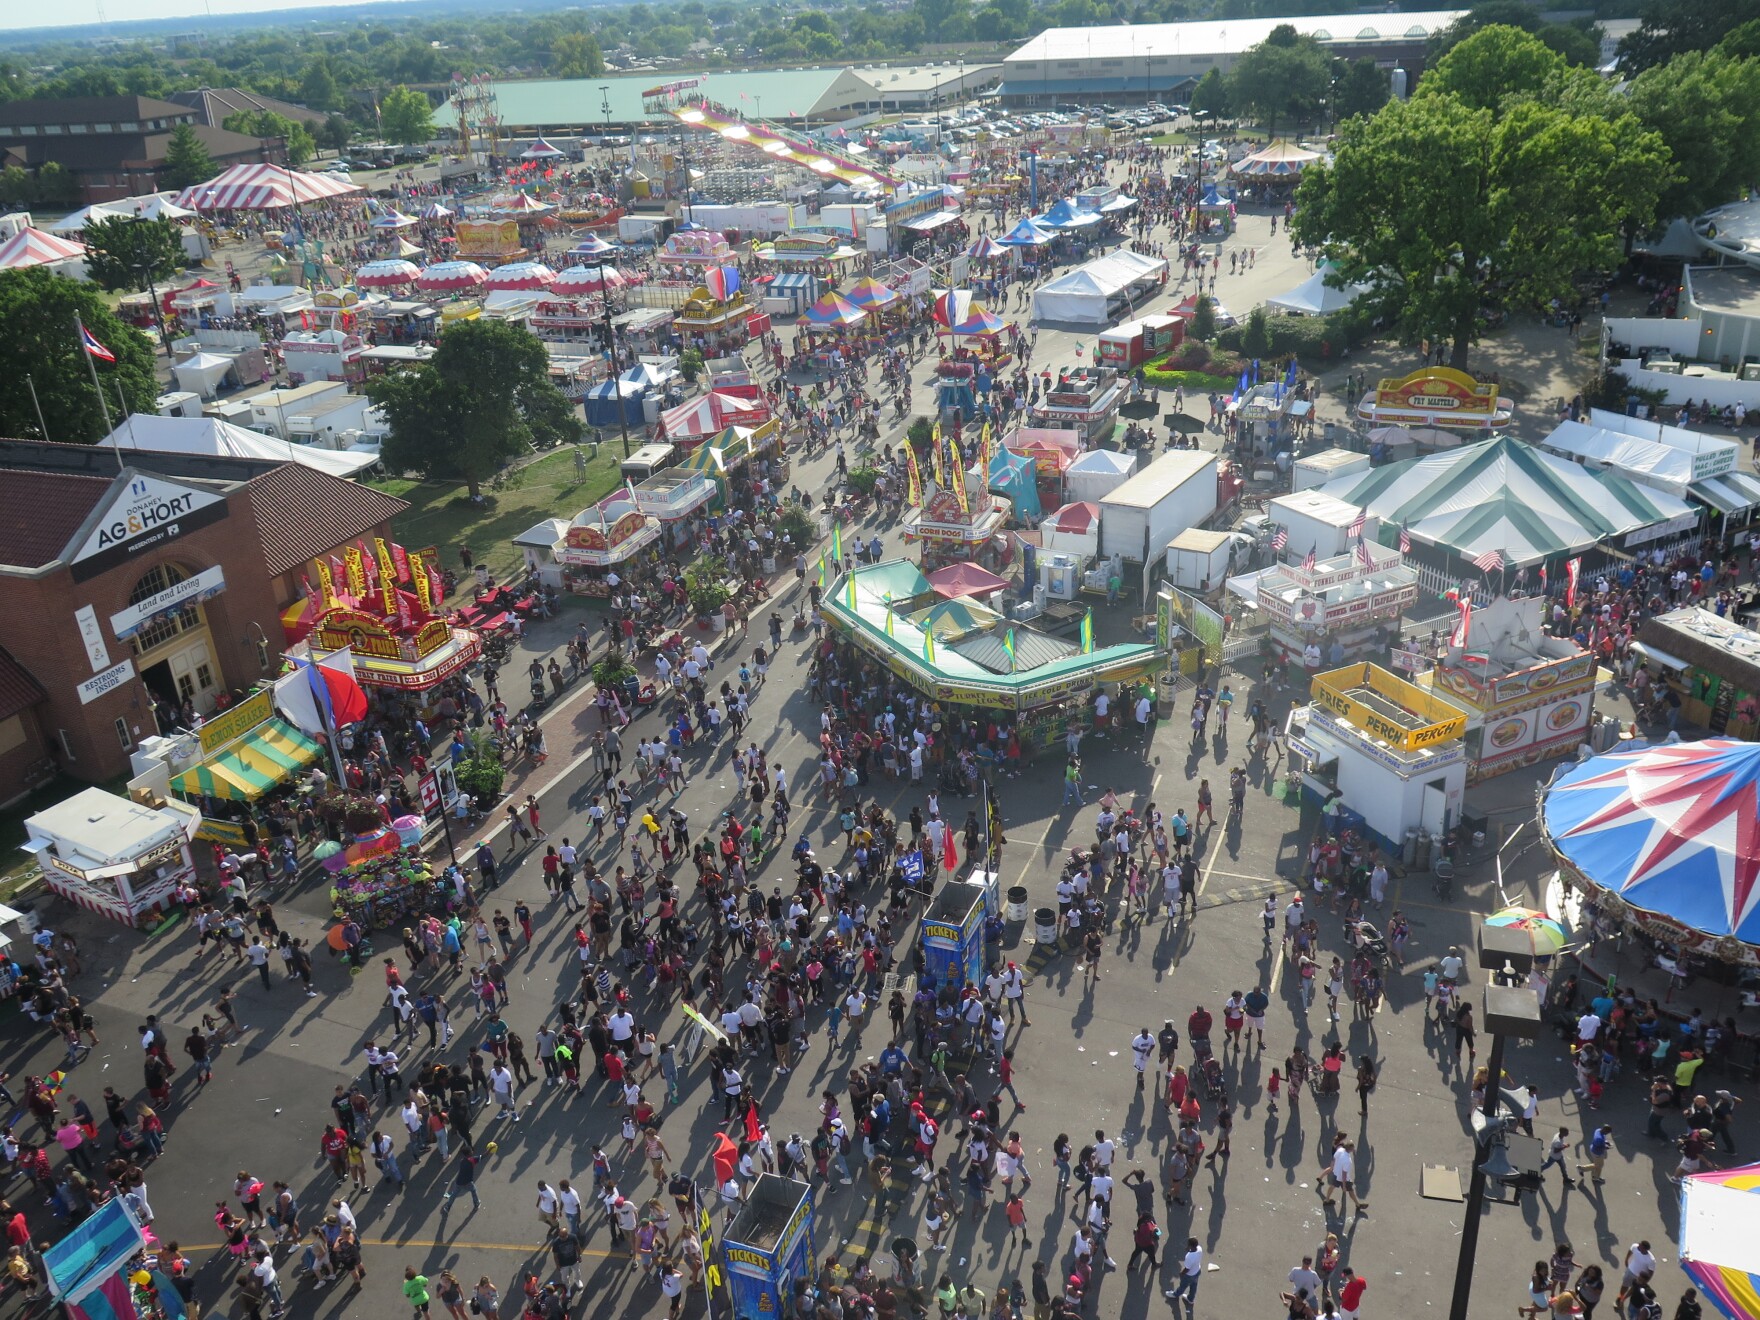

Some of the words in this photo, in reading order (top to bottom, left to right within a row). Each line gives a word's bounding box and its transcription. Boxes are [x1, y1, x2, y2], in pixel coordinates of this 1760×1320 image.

[1413, 396, 1424, 405] FRY
[1695, 452, 1716, 462] PULLED
[1718, 448, 1735, 456] PORK
[1694, 462, 1708, 471] MAC
[126, 496, 162, 516] DONAHEY
[920, 528, 941, 536] CORN
[942, 529, 962, 537] DOGS
[128, 536, 157, 552] PRESENTED
[1382, 558, 1400, 569] CAKES
[1314, 576, 1335, 588] FUNNEL
[1337, 571, 1354, 581] CAKES
[138, 598, 158, 613] Land
[160, 590, 175, 604] and
[176, 578, 200, 594] Living
[1158, 604, 1168, 648] CORN
[321, 631, 348, 649] CURLY
[370, 638, 396, 655] FRIES
[439, 659, 456, 673] CURLY
[458, 647, 473, 659] FRIES
[84, 664, 126, 692] RESTROOMS
[95, 677, 120, 694] INSIDE
[378, 673, 398, 683] FRIES
[404, 674, 420, 684] CORN
[422, 671, 436, 680] DOGS
[904, 668, 932, 696] CORN
[1025, 692, 1038, 700] ICE
[1042, 685, 1062, 695] COLD
[1066, 676, 1095, 689] DRINKS
[1320, 688, 1350, 716] FRIES
[1366, 716, 1402, 744] PERCH
[204, 723, 234, 750] LEMON
[1313, 714, 1330, 727] PERCH
[1334, 726, 1350, 740] FRIES
[1414, 722, 1456, 744] PERCH
[1292, 742, 1313, 758] PERCH
[1360, 742, 1378, 756] PERCH
[1384, 756, 1401, 770] FRIES
[1412, 760, 1433, 770] PERCH
[1440, 751, 1458, 762] FRIES
[148, 839, 179, 860] PIZZA
[366, 846, 384, 858] FANS
[58, 860, 78, 874] PIZZA
[962, 900, 986, 938] TICKETS
[926, 926, 959, 942] TICKETS
[777, 1202, 812, 1266] TICKETS
[728, 1249, 771, 1272] TICKETS
